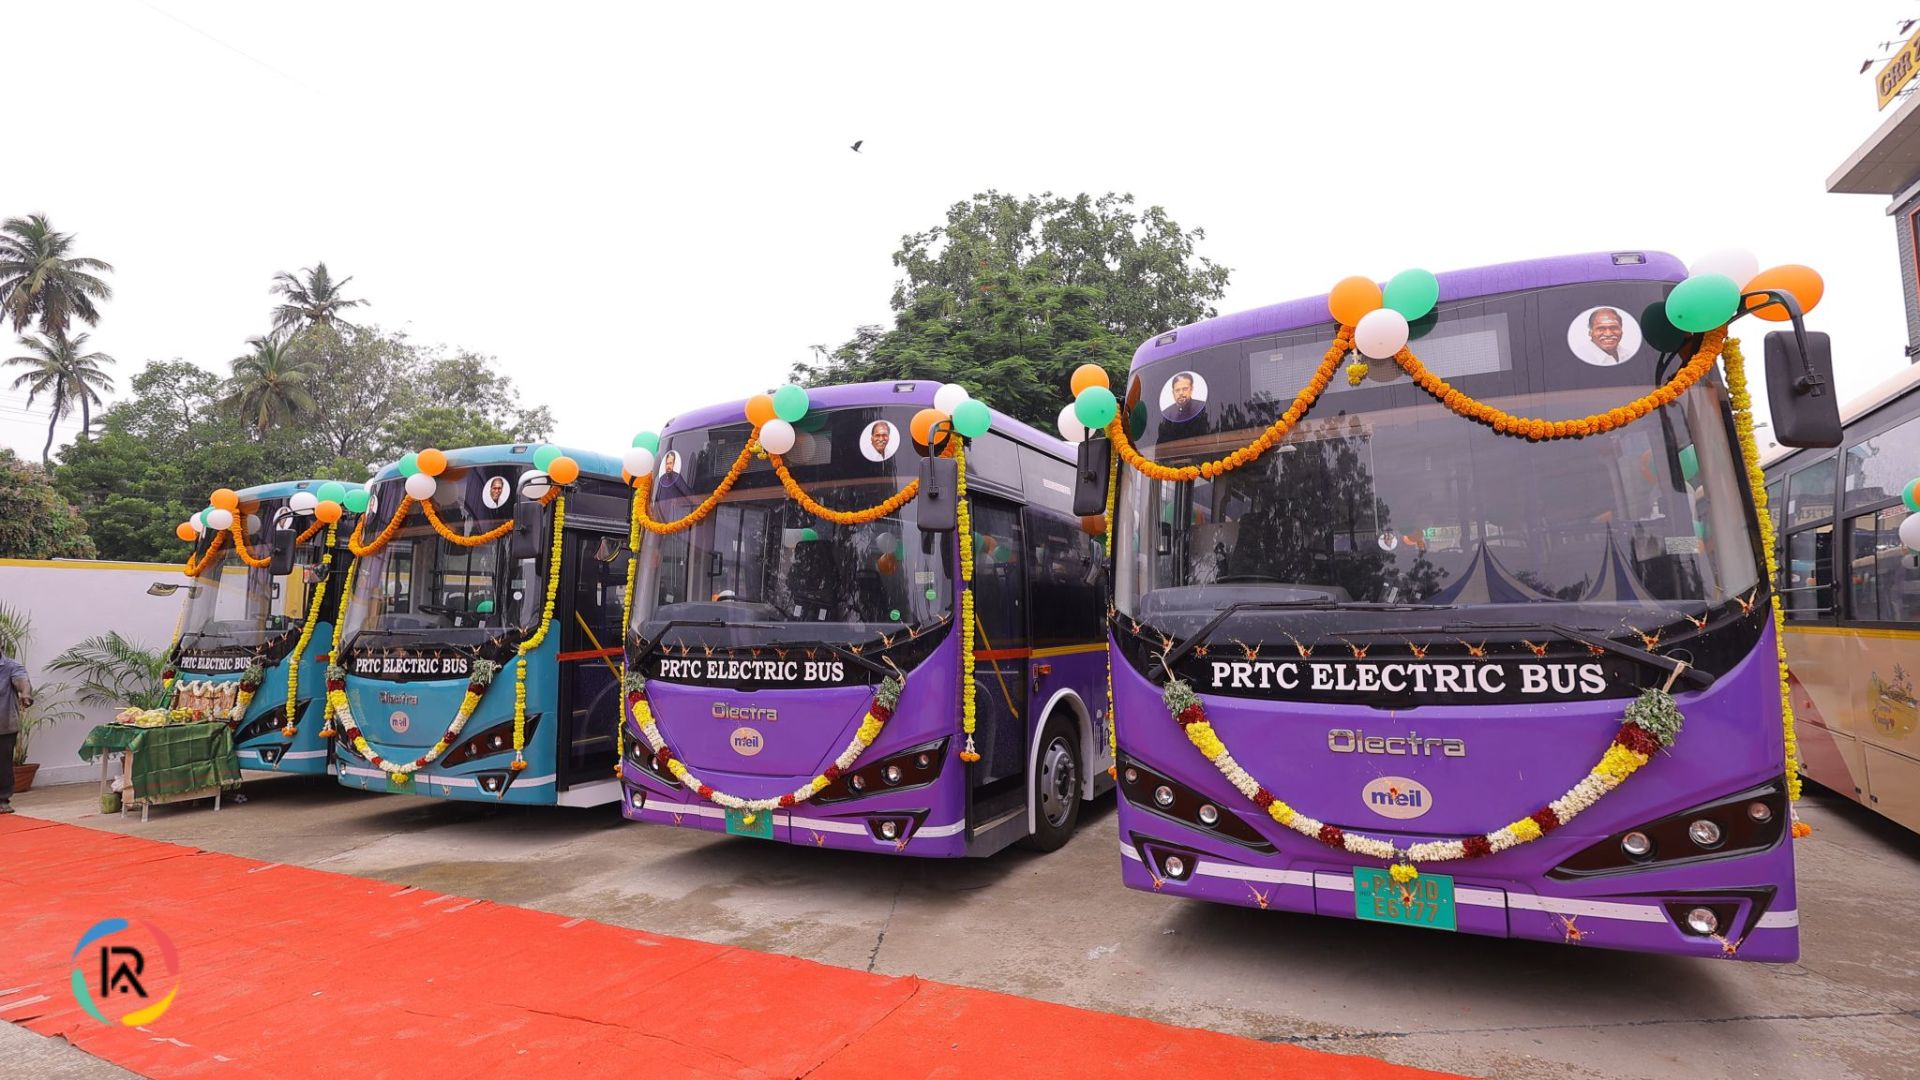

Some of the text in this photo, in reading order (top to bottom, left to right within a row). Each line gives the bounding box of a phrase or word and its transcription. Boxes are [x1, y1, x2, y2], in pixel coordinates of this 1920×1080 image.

[197, 657, 233, 670] ELECTRIC
[234, 657, 252, 670] BUS
[355, 658, 468, 673] PRTC ELECTRIC BUS
[660, 659, 844, 682] PRTC ELECTRIC BUS
[1211, 662, 1607, 694] PRTC ELECTRIC BUS
[711, 702, 778, 721] Olectra
[1327, 728, 1466, 757] Olectra
[1371, 789, 1422, 807] meil
